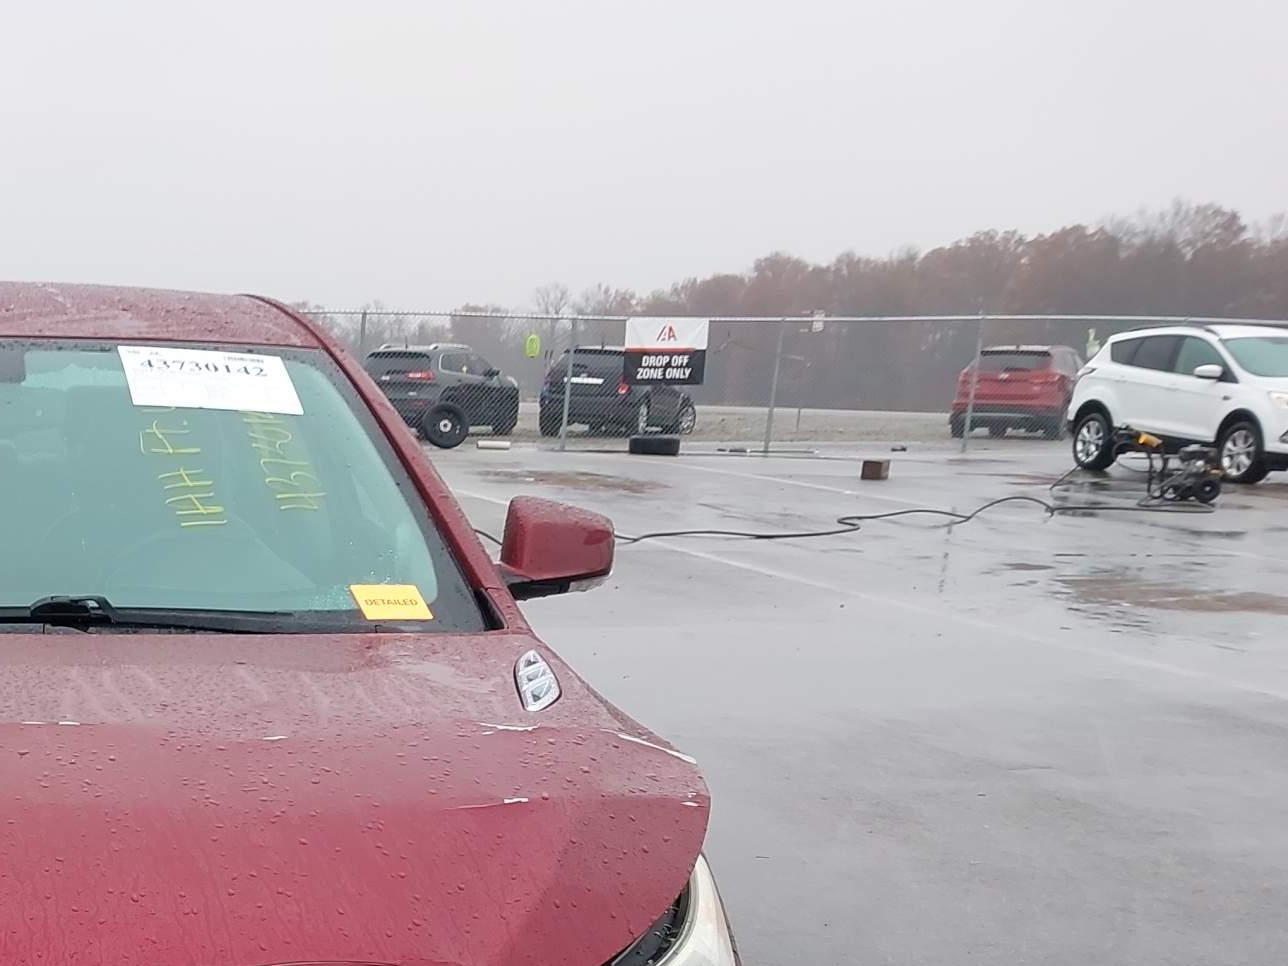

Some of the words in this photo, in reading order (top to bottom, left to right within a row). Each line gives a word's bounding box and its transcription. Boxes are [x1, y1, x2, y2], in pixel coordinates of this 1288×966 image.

[641, 355, 670, 367] DROP
[671, 355, 690, 367] OFF
[140, 359, 268, 377] 43730142
[636, 367, 664, 380] ZONE
[665, 367, 692, 379] ONLY
